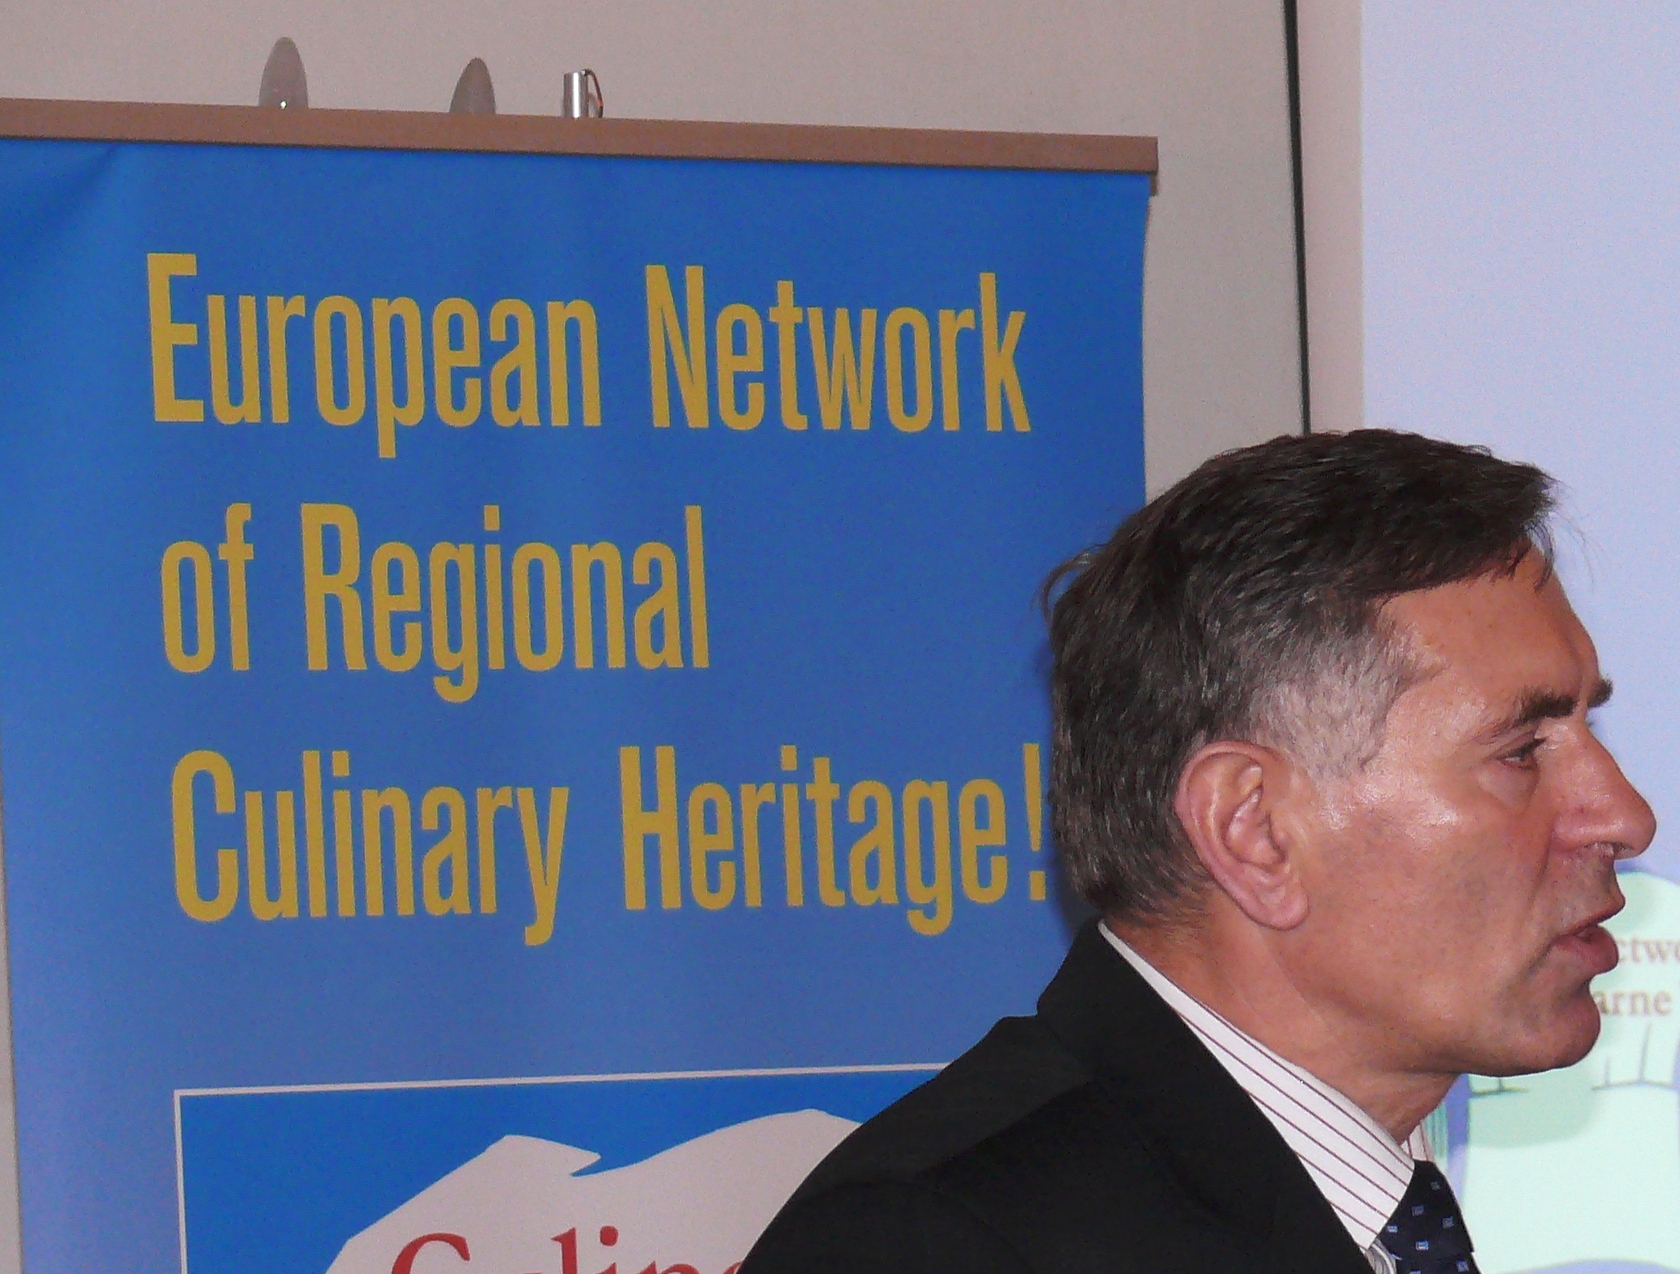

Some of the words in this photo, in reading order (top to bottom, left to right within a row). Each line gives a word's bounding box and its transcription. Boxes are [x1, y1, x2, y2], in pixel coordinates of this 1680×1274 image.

[147, 252, 601, 458] European
[644, 264, 1032, 434] Network
[160, 502, 254, 673] of
[300, 503, 710, 703] Regional
[171, 749, 570, 946] Culinary
[619, 743, 1047, 936] Heritage!
